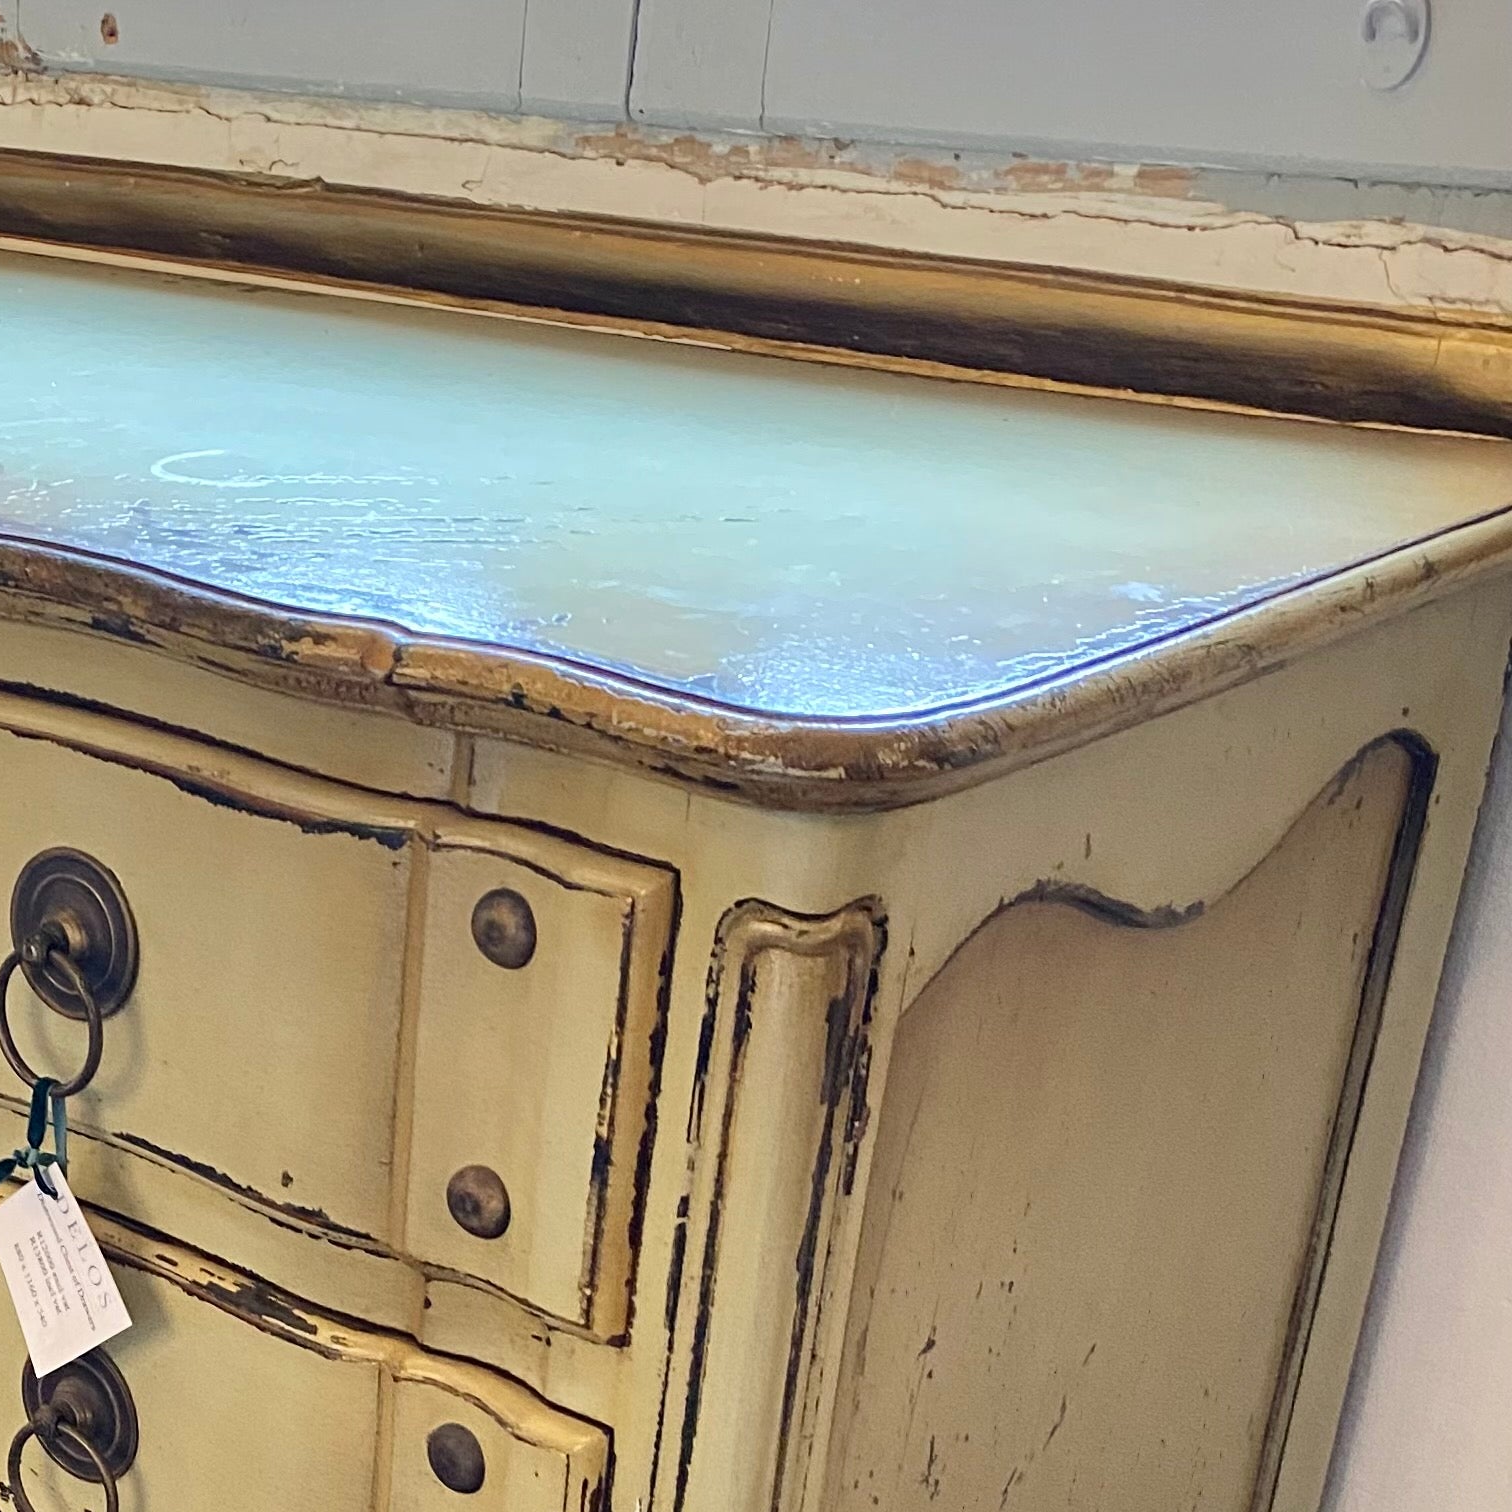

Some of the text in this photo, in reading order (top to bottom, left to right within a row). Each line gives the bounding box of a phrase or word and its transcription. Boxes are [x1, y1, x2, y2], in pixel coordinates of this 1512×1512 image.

[56, 1194, 109, 1309] DELOS
[60, 1245, 74, 1274] Chest
[72, 1275, 81, 1286] of
[77, 1288, 96, 1331] Drawers
